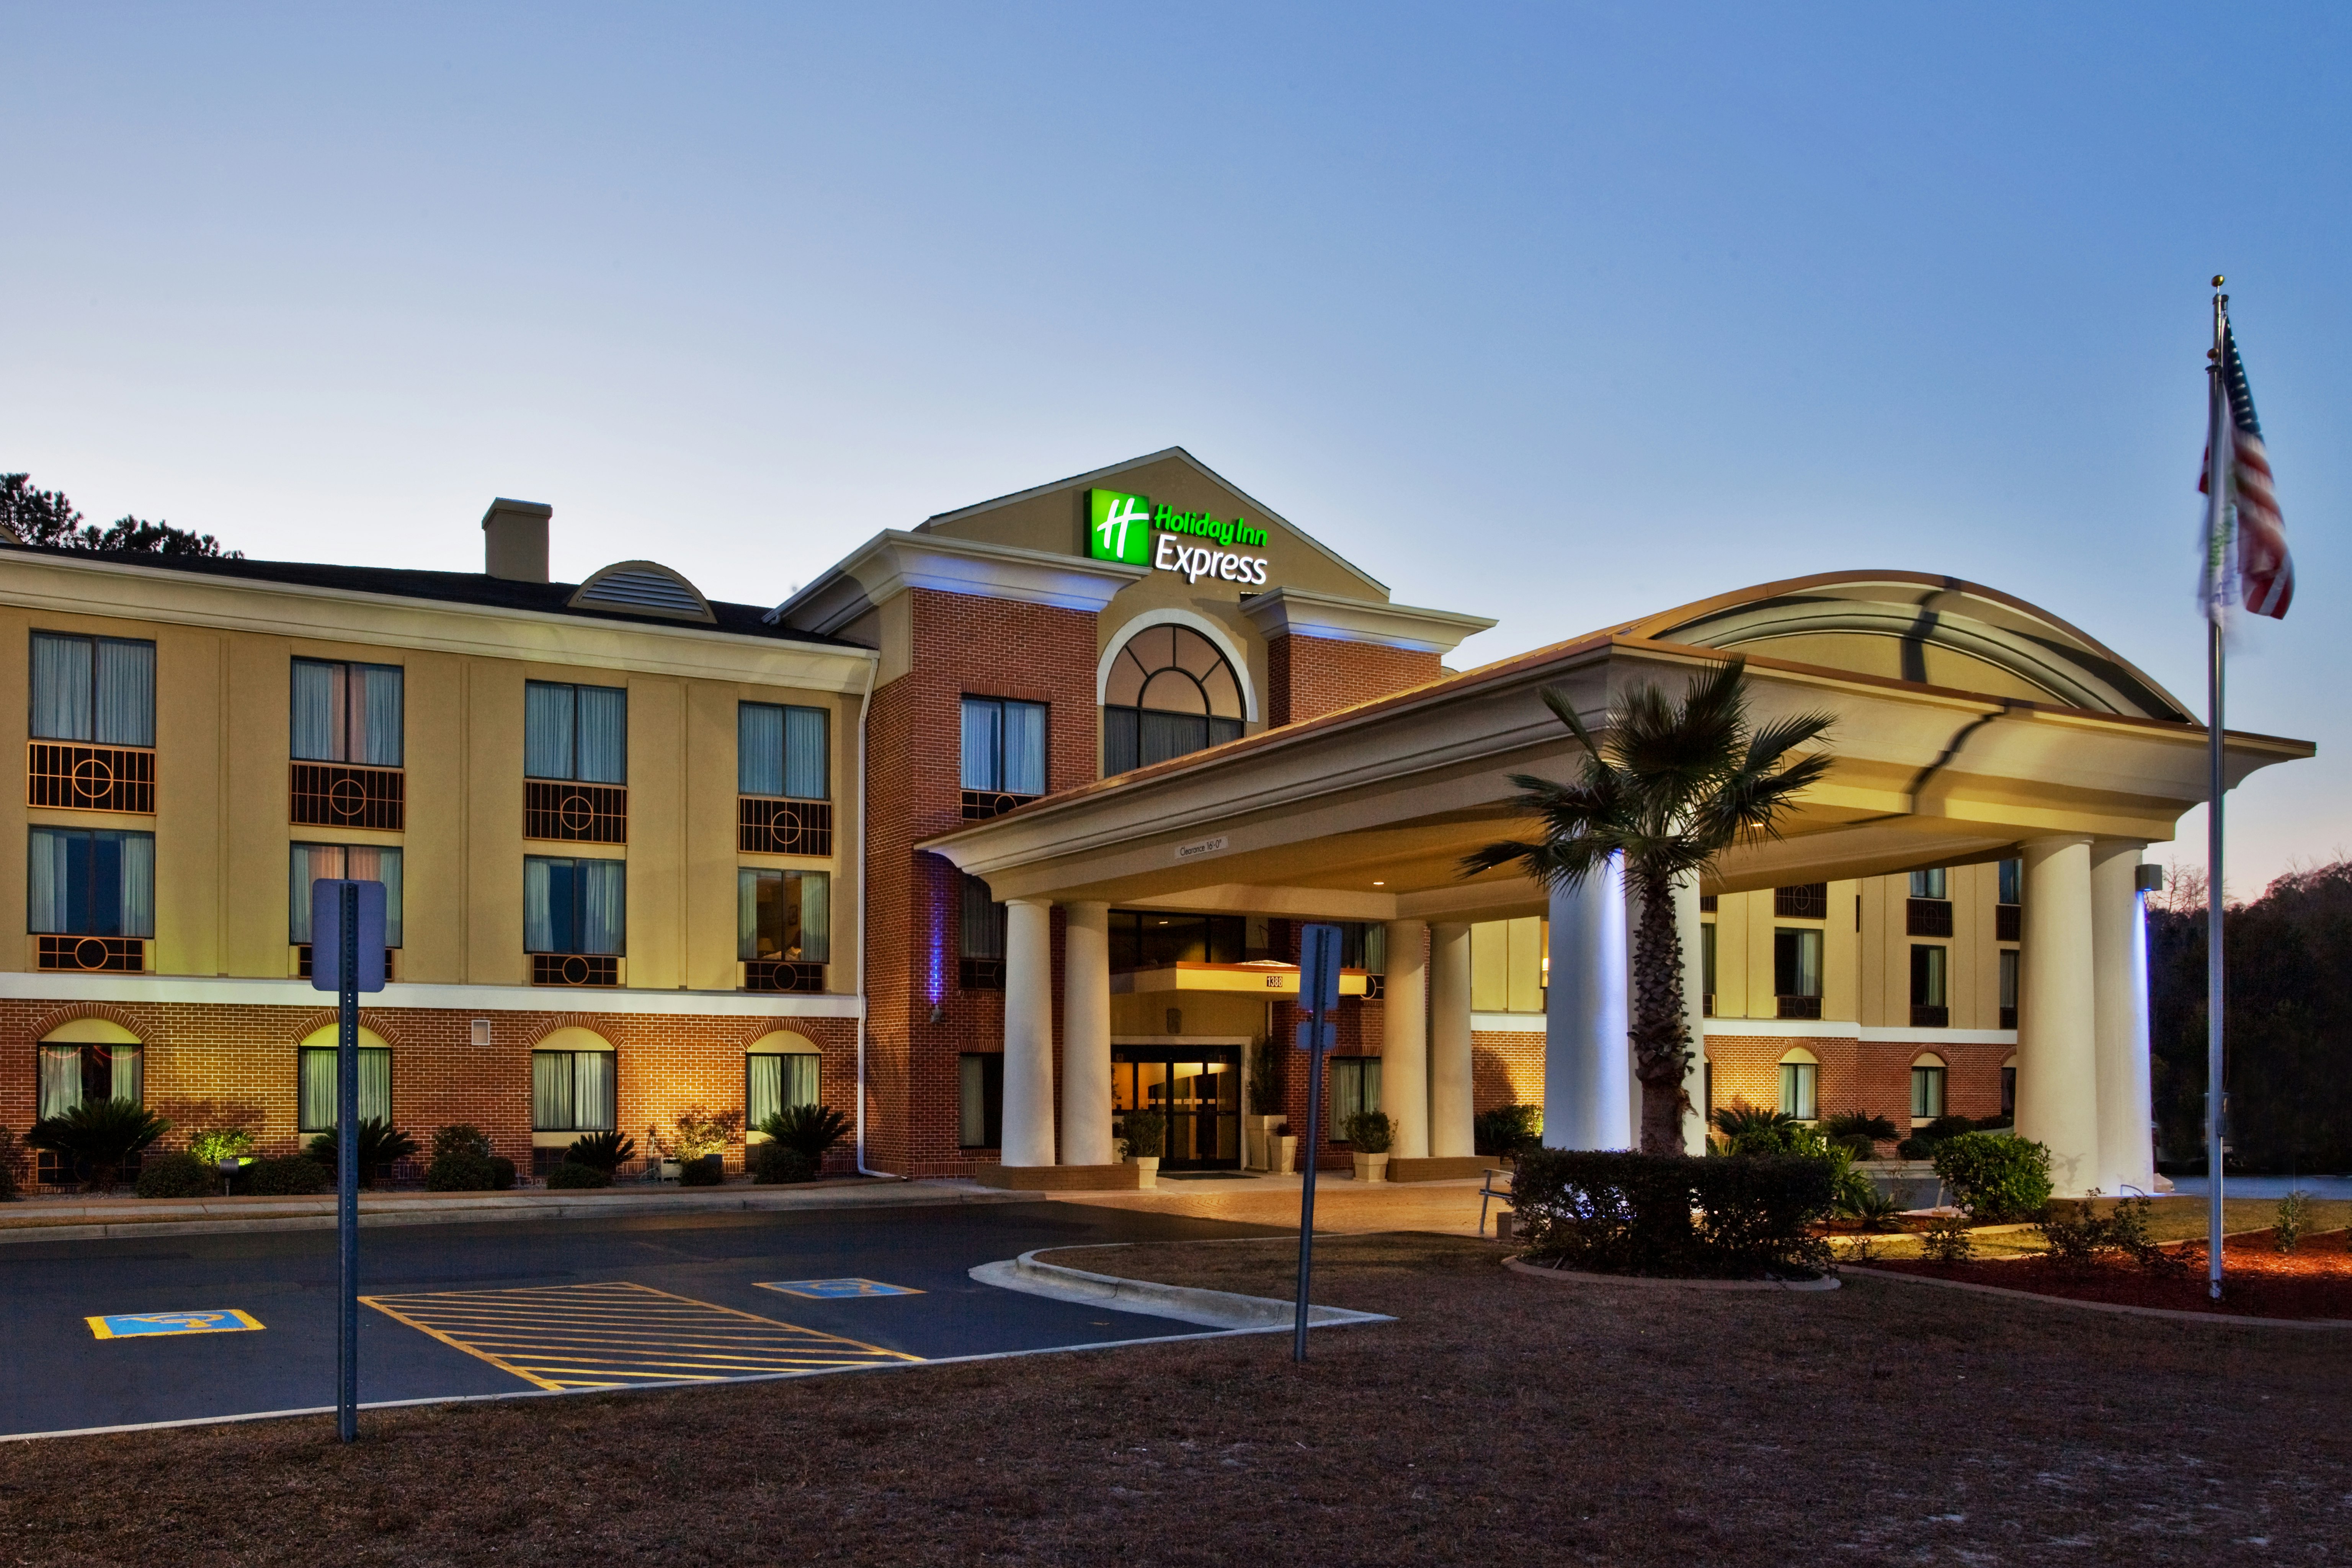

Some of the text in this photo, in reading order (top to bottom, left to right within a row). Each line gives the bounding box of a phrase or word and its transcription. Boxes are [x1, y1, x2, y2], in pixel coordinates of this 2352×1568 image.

[1097, 498, 1149, 558] H
[1154, 503, 1267, 547] Holiday Inn
[1155, 534, 1268, 585] Express
[1180, 846, 1205, 856] Clearance
[1267, 977, 1282, 987] 1388
